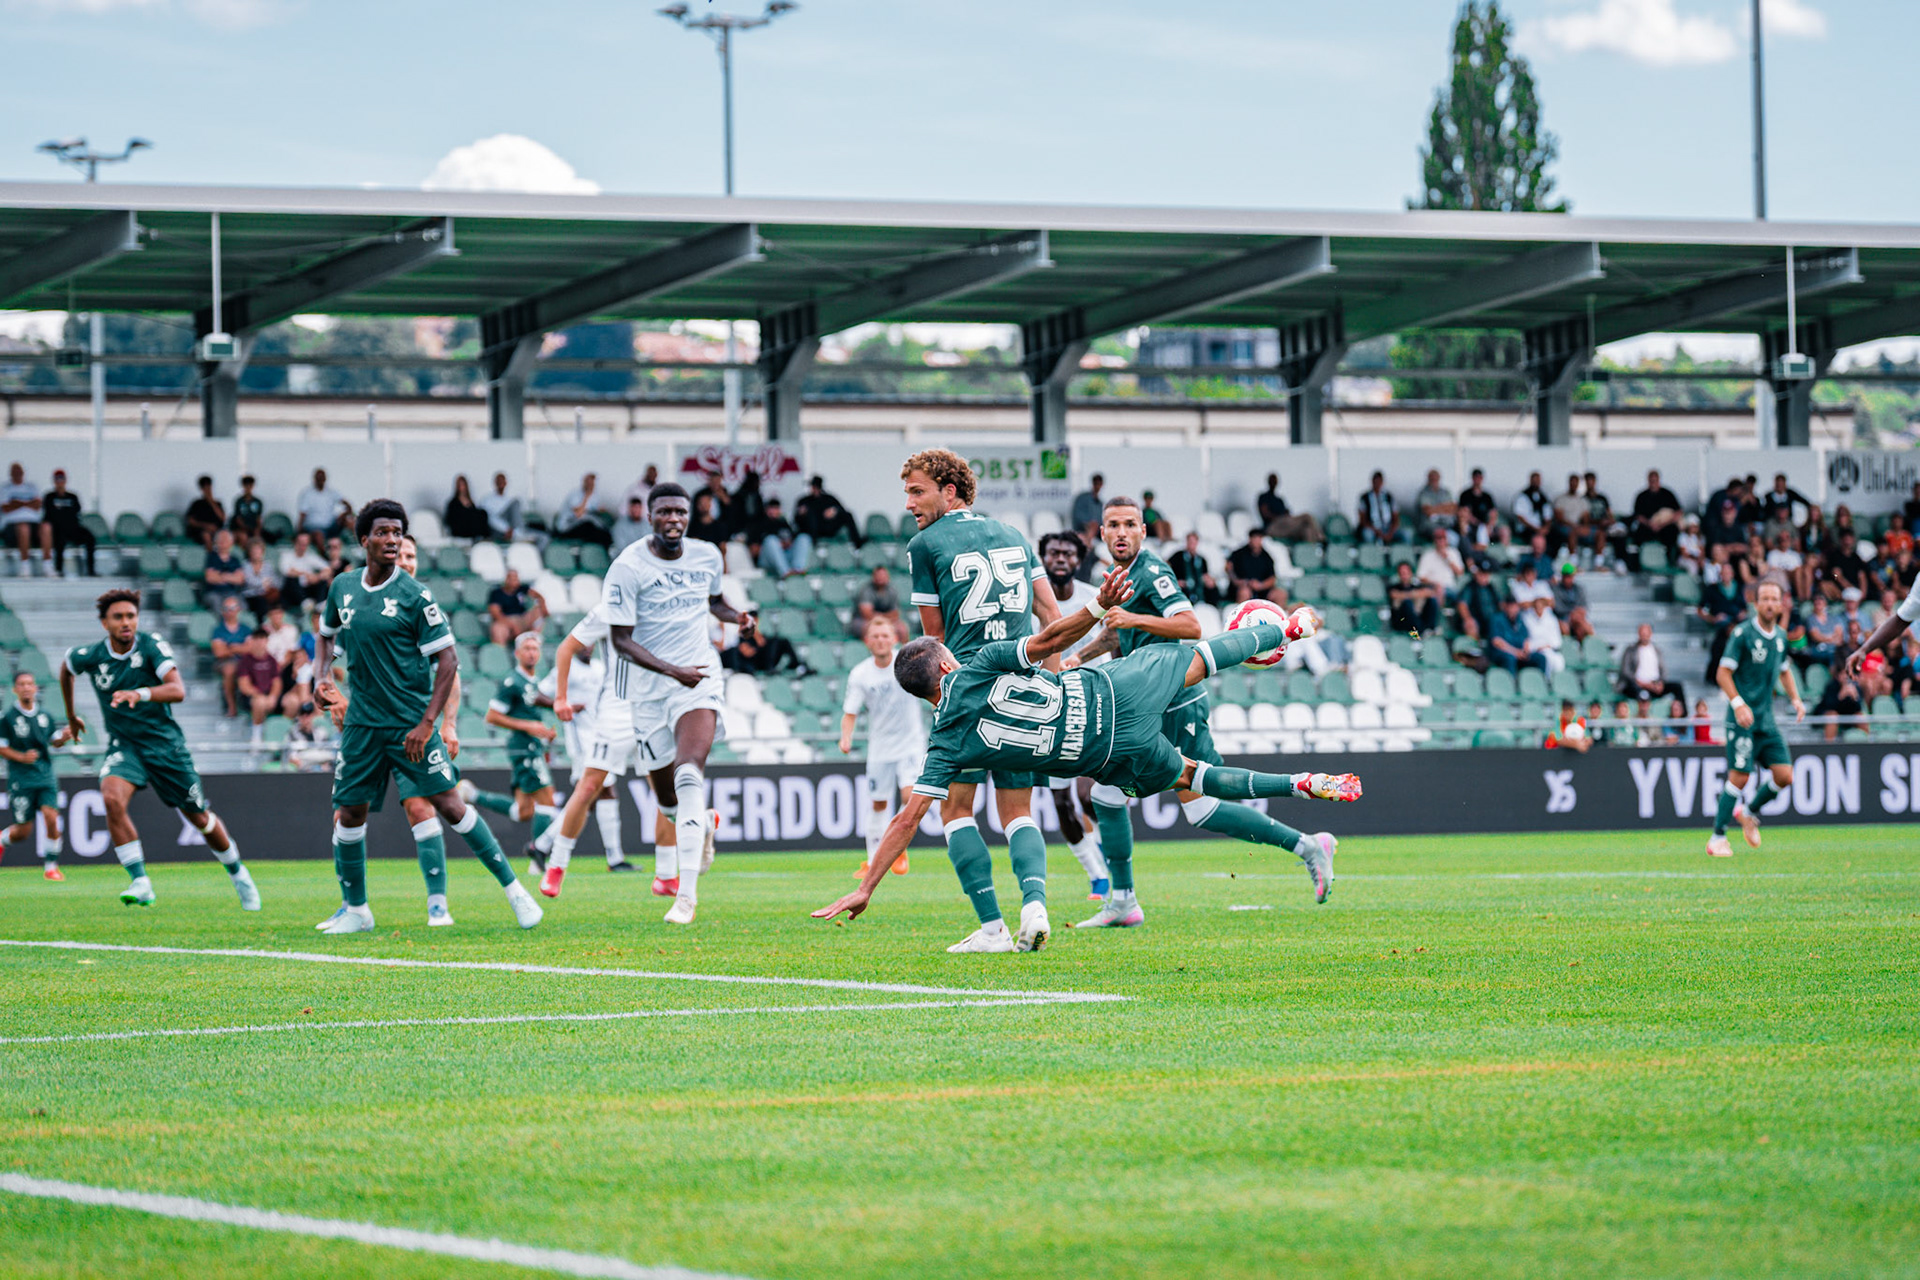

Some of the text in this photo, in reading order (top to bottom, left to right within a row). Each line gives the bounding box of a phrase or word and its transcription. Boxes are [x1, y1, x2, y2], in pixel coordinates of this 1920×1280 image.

[951, 546, 1027, 625] 25
[984, 620, 1007, 640] POS
[976, 672, 1064, 757] 10
[1058, 672, 1088, 761] MARCHESANO
[628, 774, 898, 845] YERDO
